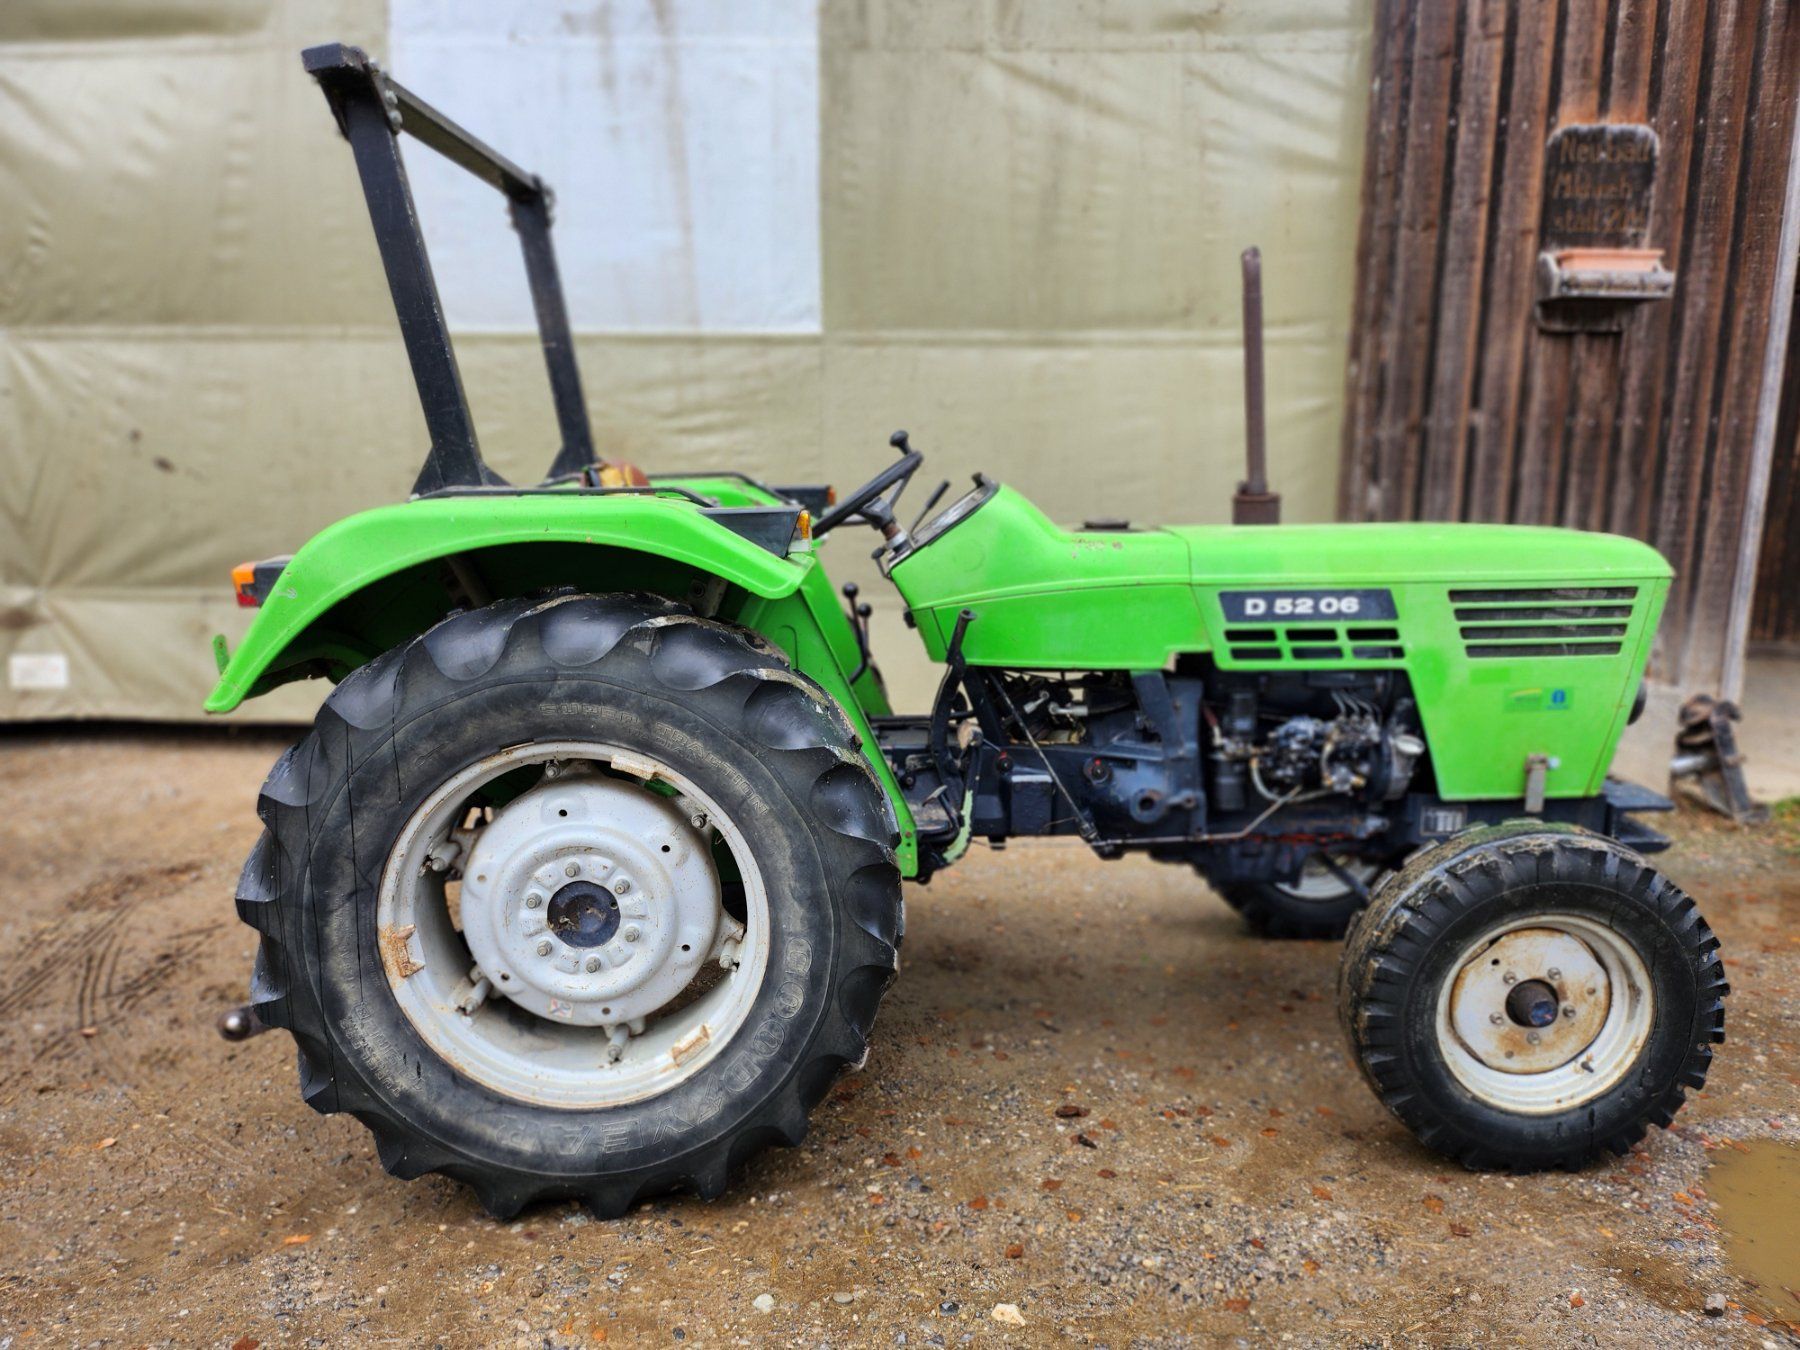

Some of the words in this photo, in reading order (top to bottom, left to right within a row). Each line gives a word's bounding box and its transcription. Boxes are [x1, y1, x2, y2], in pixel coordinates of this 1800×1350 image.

[1244, 598, 1267, 616] D
[653, 720, 770, 816] TRACTION
[496, 937, 814, 1155] GOODYEAR
